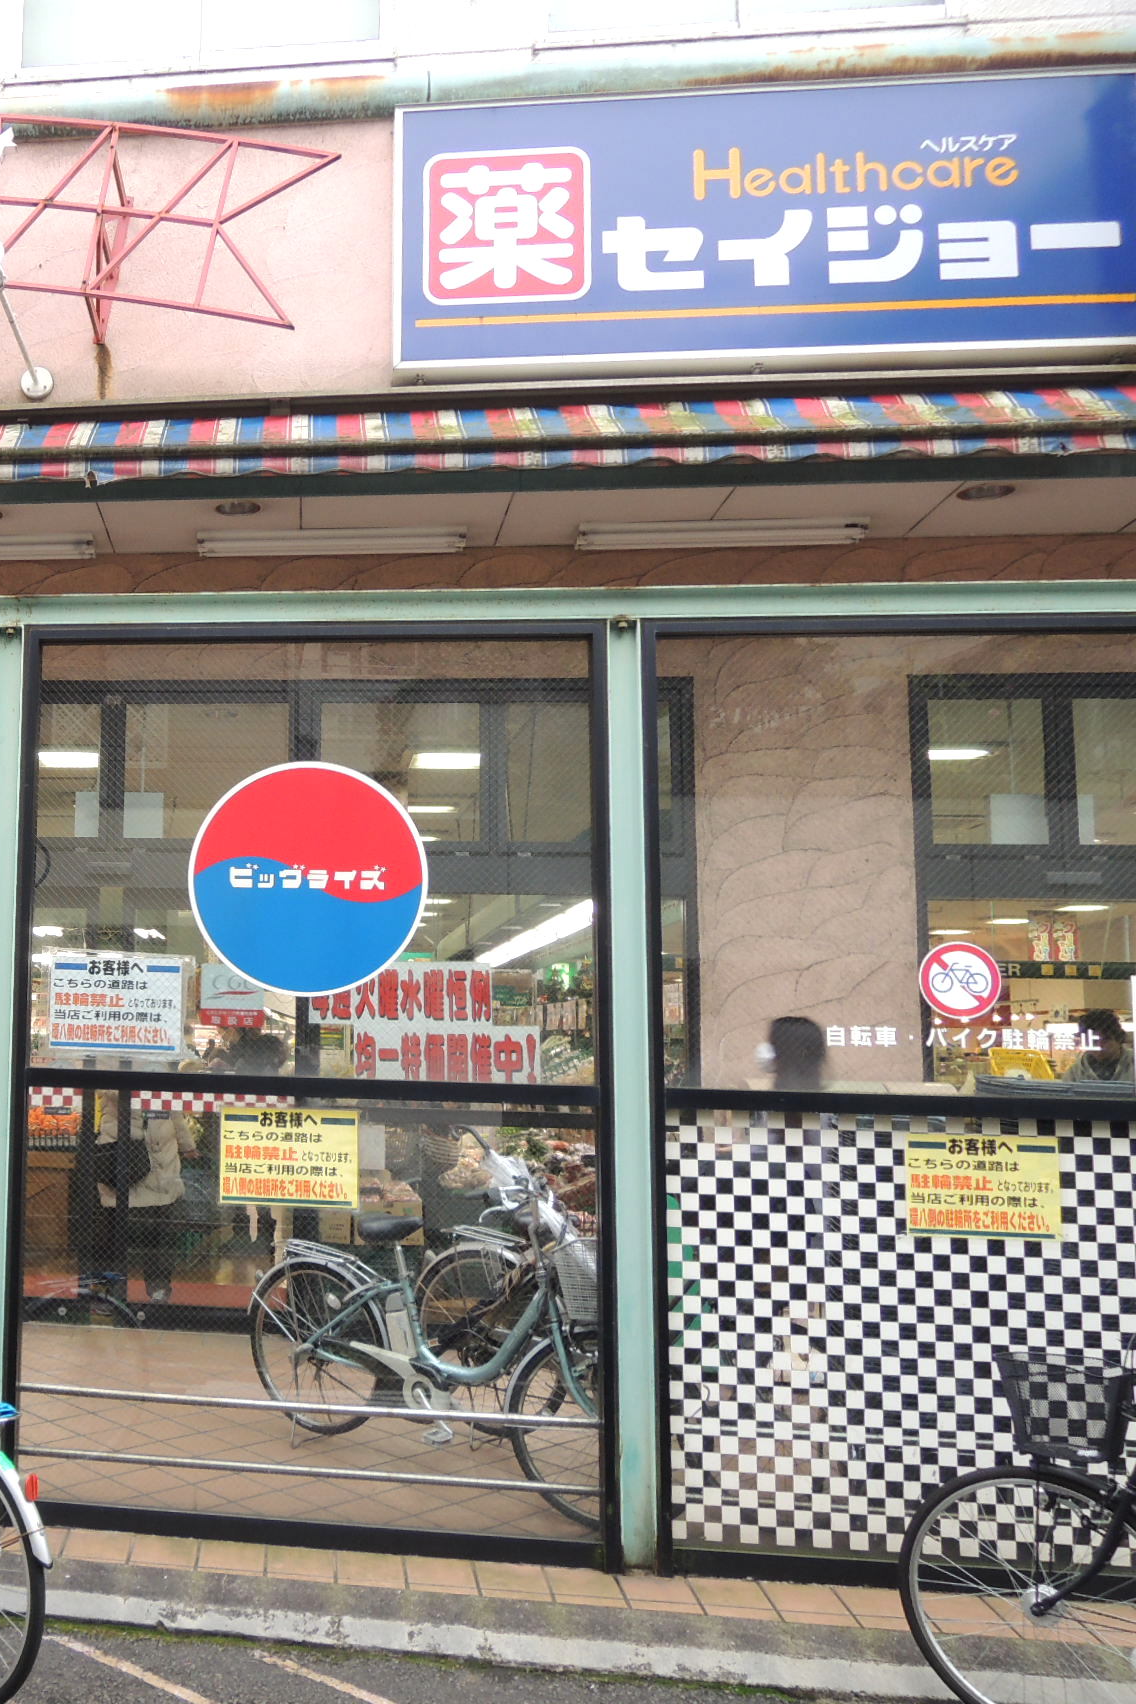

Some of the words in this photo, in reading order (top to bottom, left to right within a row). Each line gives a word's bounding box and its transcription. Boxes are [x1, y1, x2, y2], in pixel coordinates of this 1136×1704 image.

[919, 133, 1018, 153] ヘルスケア
[692, 146, 1019, 201] Healthcare
[437, 161, 575, 290] 薬
[602, 203, 1121, 292] セイジョー
[229, 862, 387, 891] ビッグライズ
[88, 960, 144, 976] お客様へ
[53, 978, 148, 990] こちらの道路は
[55, 992, 125, 1008] 駐輪禁止
[54, 1009, 167, 1023] 当店ご利用の際は、
[259, 1111, 318, 1129] お客様へ
[224, 1129, 323, 1143] こちらの道路は
[225, 1145, 298, 1161] 駐輪禁止
[948, 1138, 1013, 1157] お客様へ
[224, 1162, 343, 1177] 当店ご利用の際は、
[908, 1158, 1020, 1172] こちらの道路は
[911, 1174, 993, 1191] 駐輪禁止
[911, 1192, 1045, 1208] 当店ご利用の際は、
